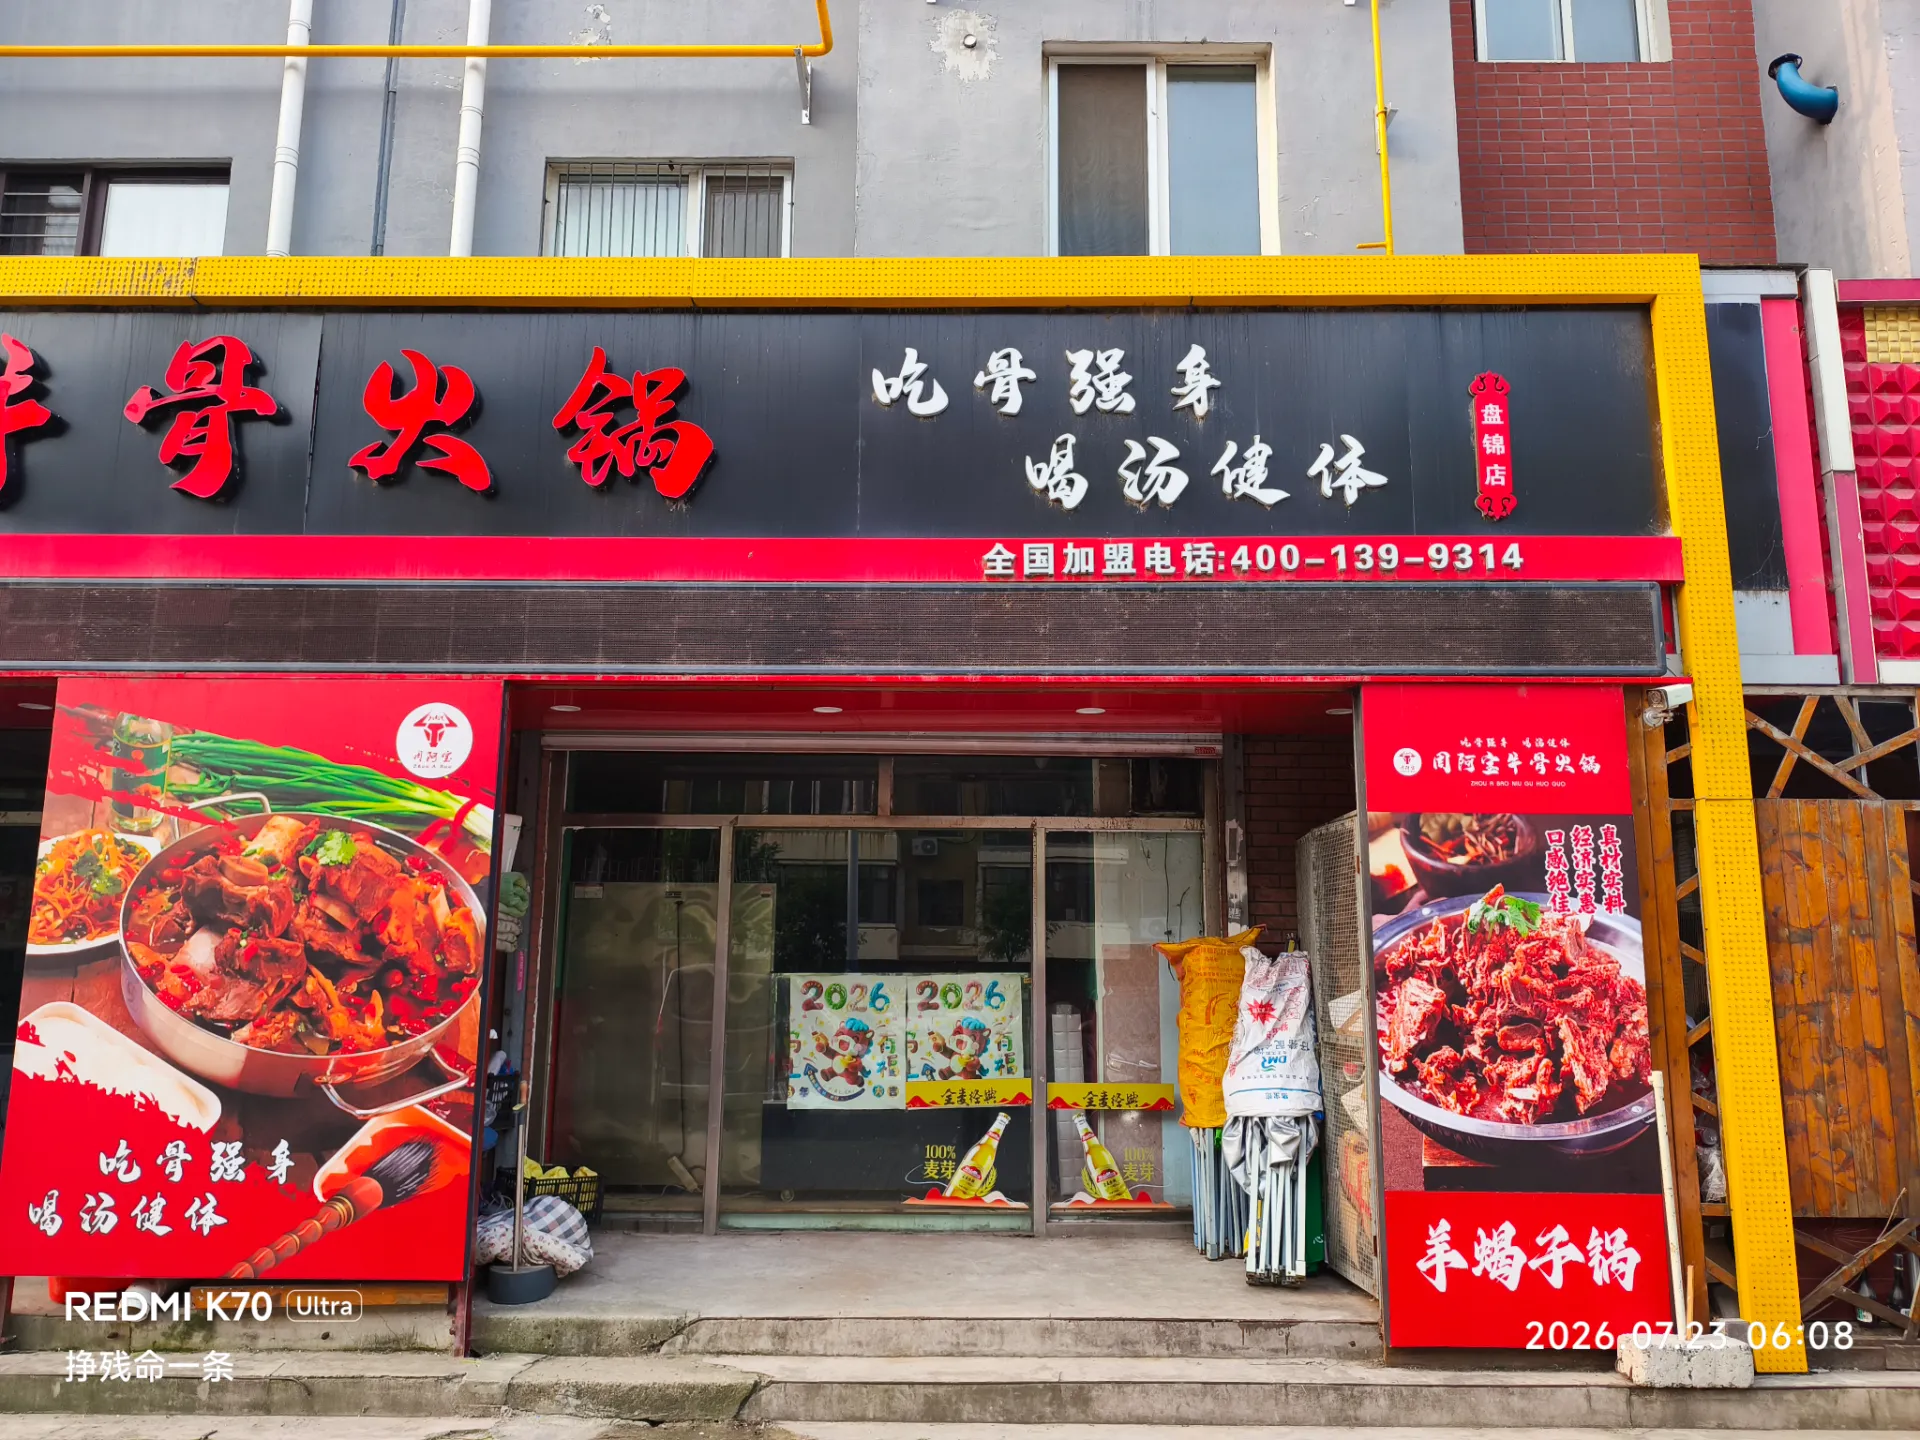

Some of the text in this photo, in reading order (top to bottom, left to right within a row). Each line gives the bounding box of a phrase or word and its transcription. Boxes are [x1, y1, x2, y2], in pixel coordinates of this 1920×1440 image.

[872, 343, 1222, 418] 吃骨强身
[1481, 403, 1506, 487] 盘锦店
[1025, 433, 1388, 510] 喝汤健体
[1433, 751, 1601, 776] 周阿宝牛骨火锅
[1545, 829, 1571, 914] 口感绝佳
[1570, 825, 1597, 915] 经济实惠
[1598, 824, 1627, 916] 真材实料
[800, 980, 891, 1014] 2026
[915, 979, 1007, 1013] 2026
[99, 1138, 295, 1186] 吃骨强身
[923, 1160, 956, 1180] 麦芽
[925, 1144, 956, 1160] 100%
[1123, 1147, 1155, 1161] 100%
[1123, 1162, 1155, 1182] 麦芽
[28, 1189, 228, 1238] 喝汤健体
[1416, 1218, 1641, 1293] 羊蝎子锅
